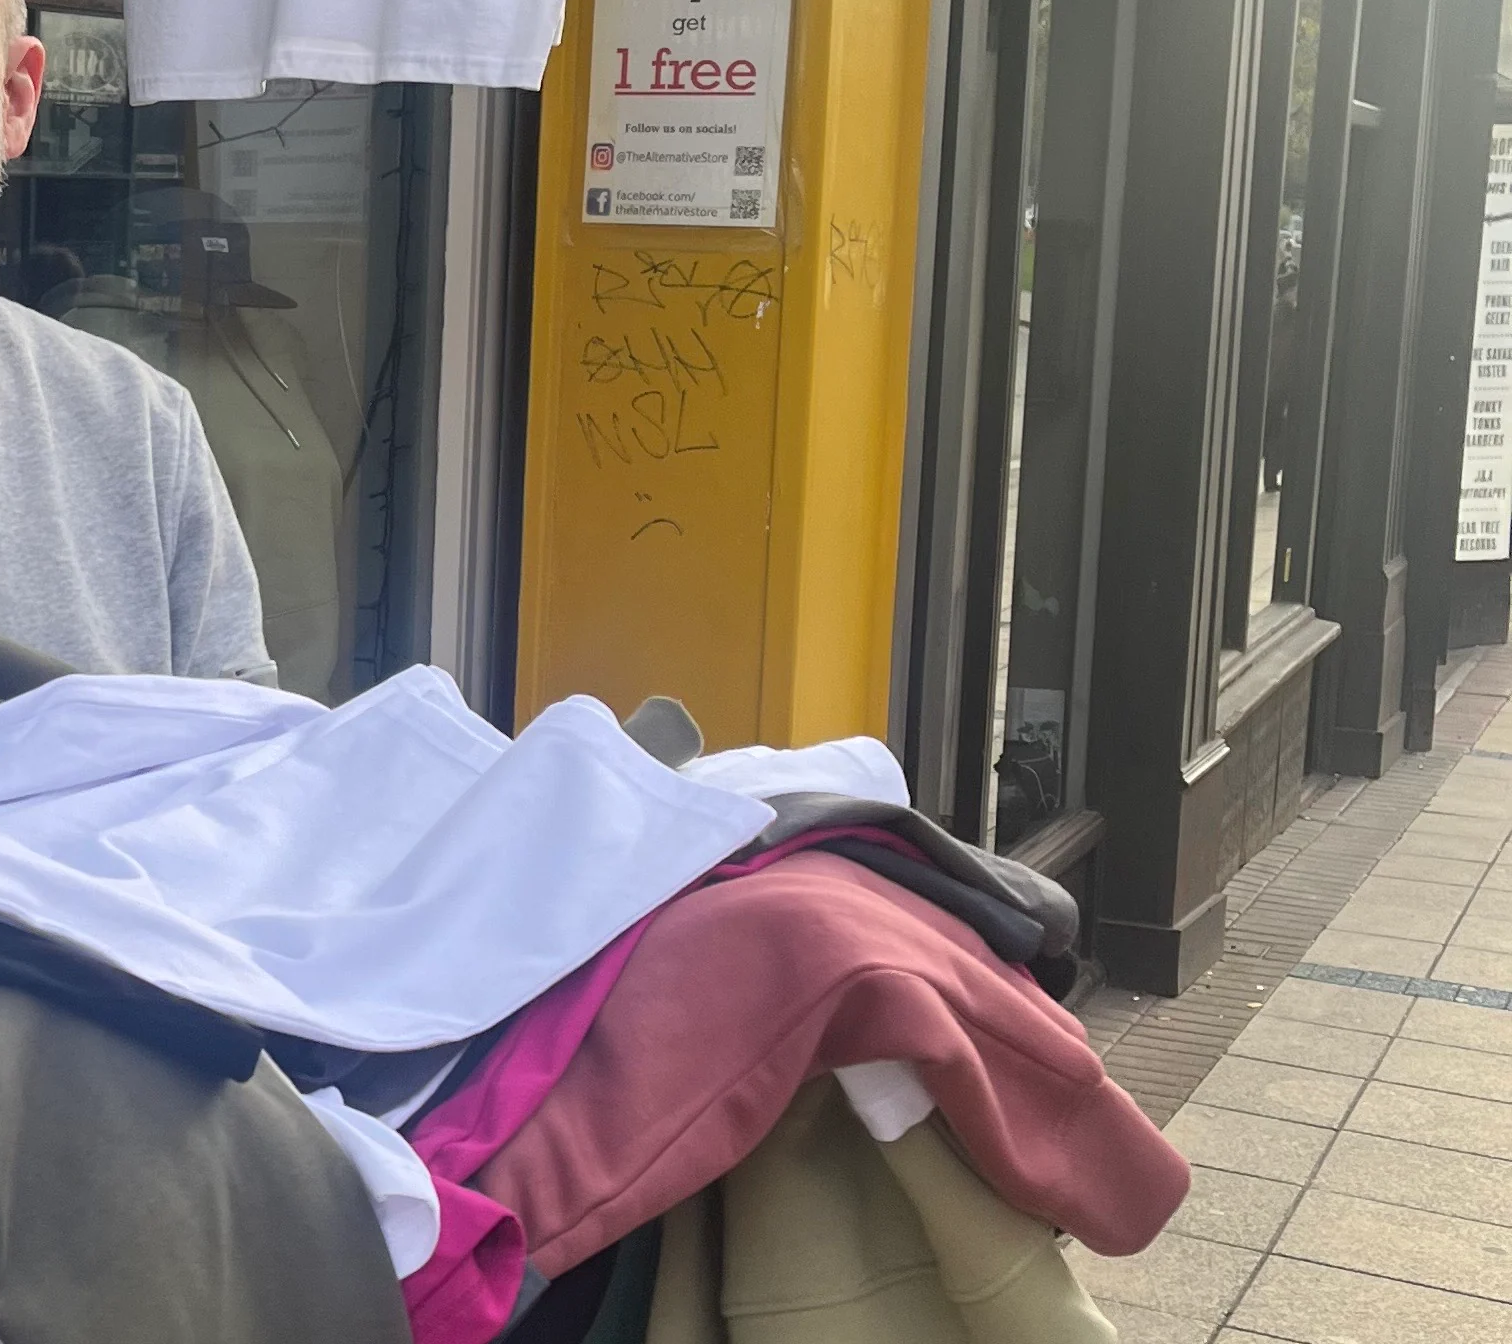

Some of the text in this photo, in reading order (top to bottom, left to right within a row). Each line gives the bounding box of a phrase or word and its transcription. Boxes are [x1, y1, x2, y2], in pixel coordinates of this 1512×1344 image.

[672, 15, 707, 36] get
[614, 47, 757, 91] 1 free
[624, 122, 737, 135] Follow us on socials!
[616, 150, 729, 165] @TheAlternativeStore
[616, 188, 696, 204] facebook.com/
